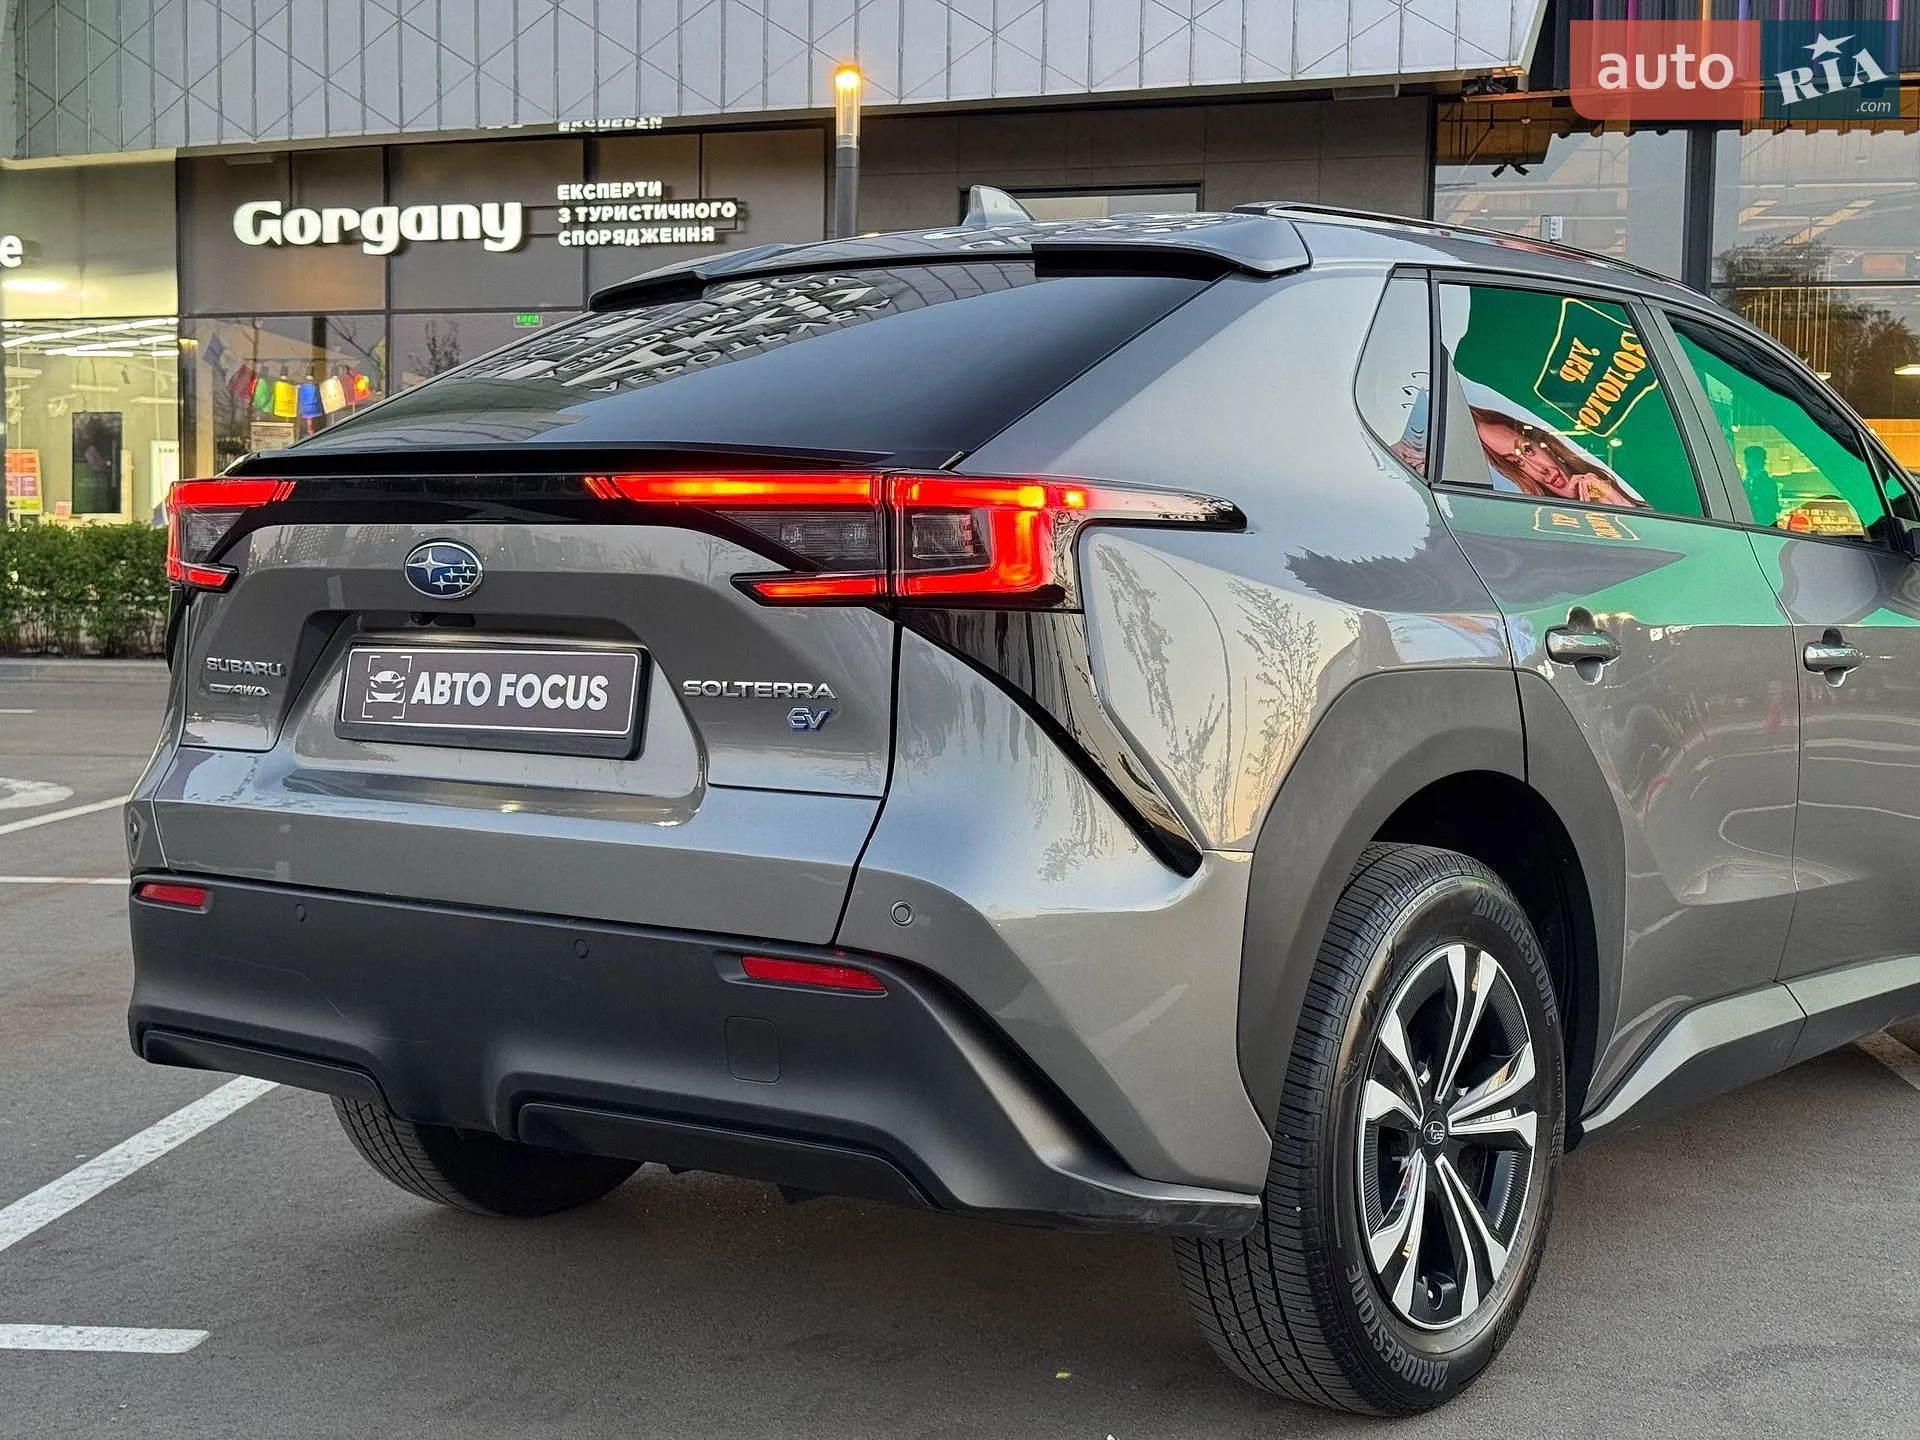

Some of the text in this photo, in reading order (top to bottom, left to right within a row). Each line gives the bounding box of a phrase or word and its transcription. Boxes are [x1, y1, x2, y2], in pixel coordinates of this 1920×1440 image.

[557, 180, 663, 201] ЕКСПЕРТИ
[574, 201, 738, 223] ТУРИСТИЧНОГО
[232, 200, 523, 256] Gorgany
[557, 226, 716, 247] СПОРЯДЖЕННЯ
[206, 656, 283, 677] SUBARU
[498, 673, 609, 711] FOCUS
[682, 680, 838, 699] SOLTERRA
[786, 706, 832, 732] EV
[1472, 888, 1557, 1026] BRIDGESTONE
[1346, 1260, 1450, 1392] BRIDGESTONE
